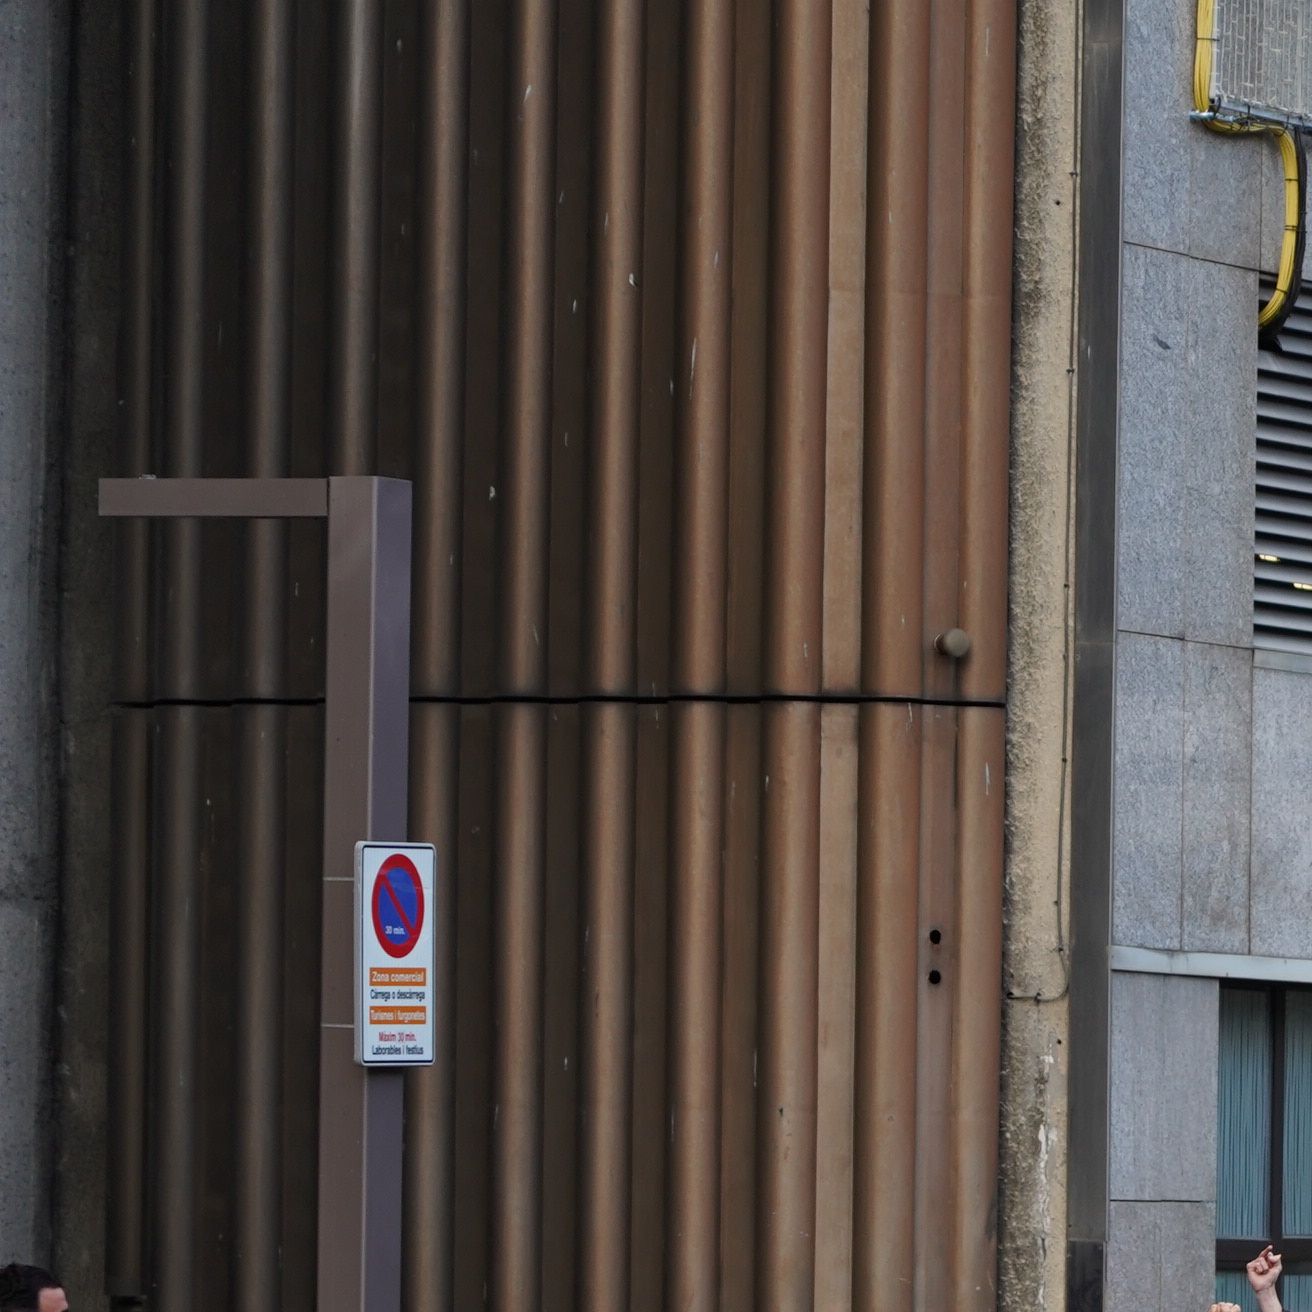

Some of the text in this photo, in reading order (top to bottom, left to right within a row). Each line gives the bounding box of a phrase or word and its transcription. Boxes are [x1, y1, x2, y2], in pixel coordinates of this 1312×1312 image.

[384, 925, 393, 934] 30
[371, 971, 424, 982] Zona comercial
[398, 1032, 404, 1042] 30
[372, 1044, 402, 1055] Laborables
[406, 1045, 424, 1056] festius
